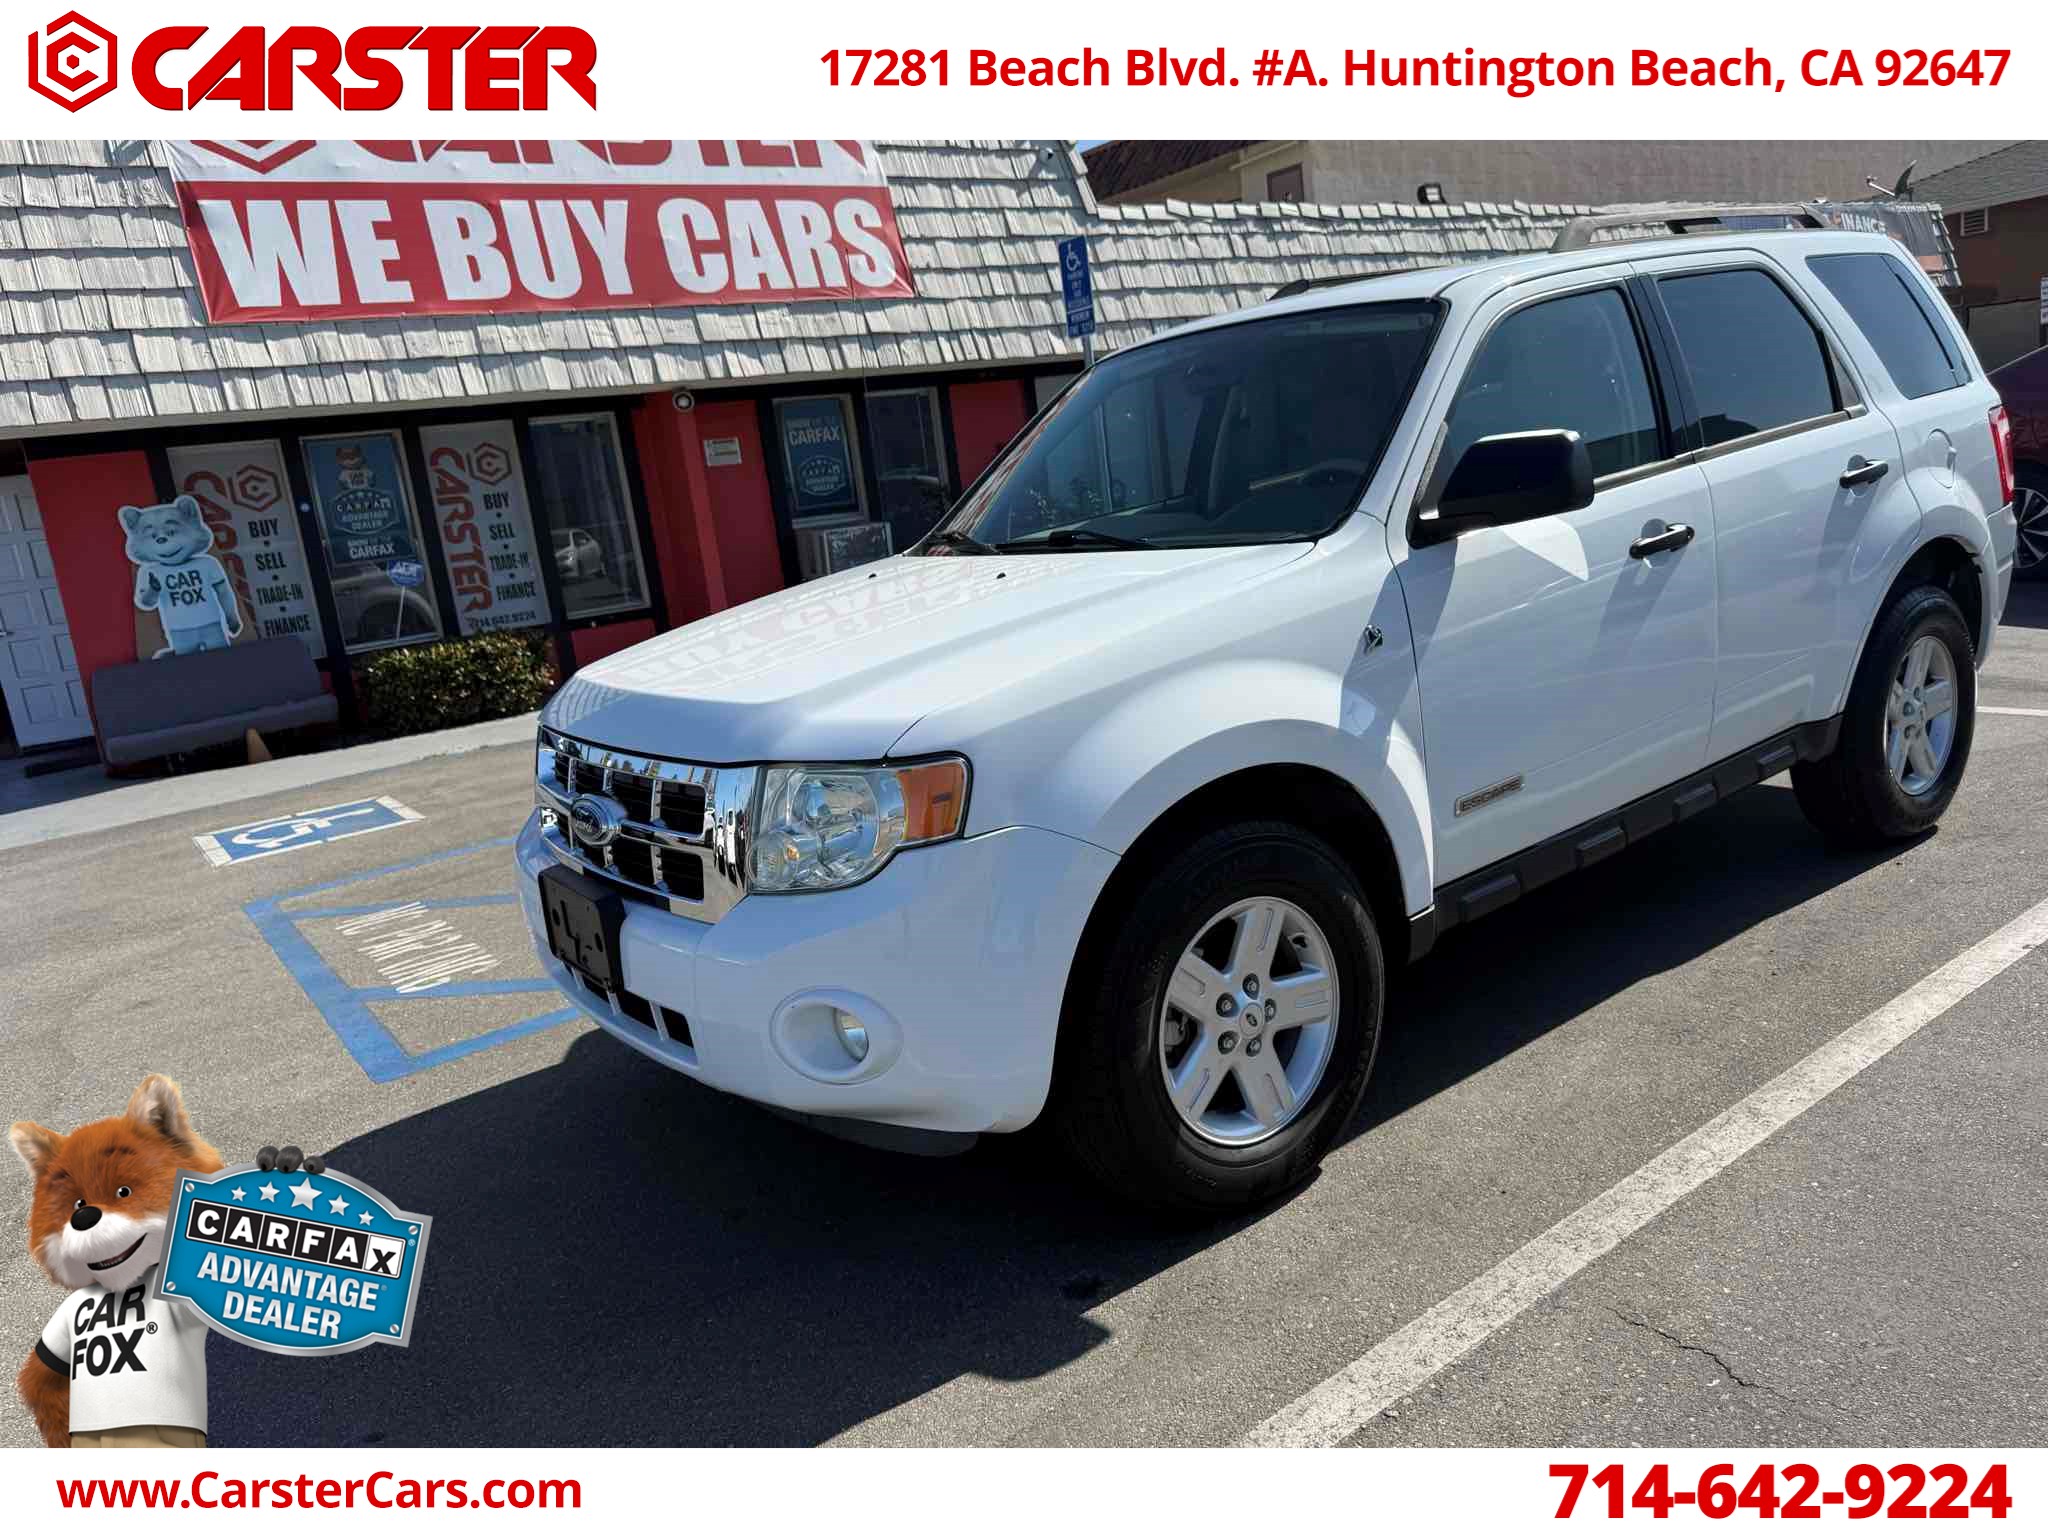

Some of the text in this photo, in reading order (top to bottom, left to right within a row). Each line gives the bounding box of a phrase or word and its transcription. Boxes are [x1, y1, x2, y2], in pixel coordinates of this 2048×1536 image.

[196, 197, 898, 308] WE BUY CARS
[483, 491, 510, 511] BUY
[248, 518, 280, 539] BUY
[431, 447, 493, 613] CARSTER
[488, 521, 516, 541] SELL
[349, 541, 396, 560] CARFAX
[255, 551, 288, 572] SELL
[488, 551, 529, 572] TRADE-IN
[165, 569, 203, 590] CAR
[169, 588, 207, 608] FOX
[256, 583, 304, 607] TRADE-IN
[496, 581, 537, 601] FINANCE
[263, 613, 312, 639] FINANCE
